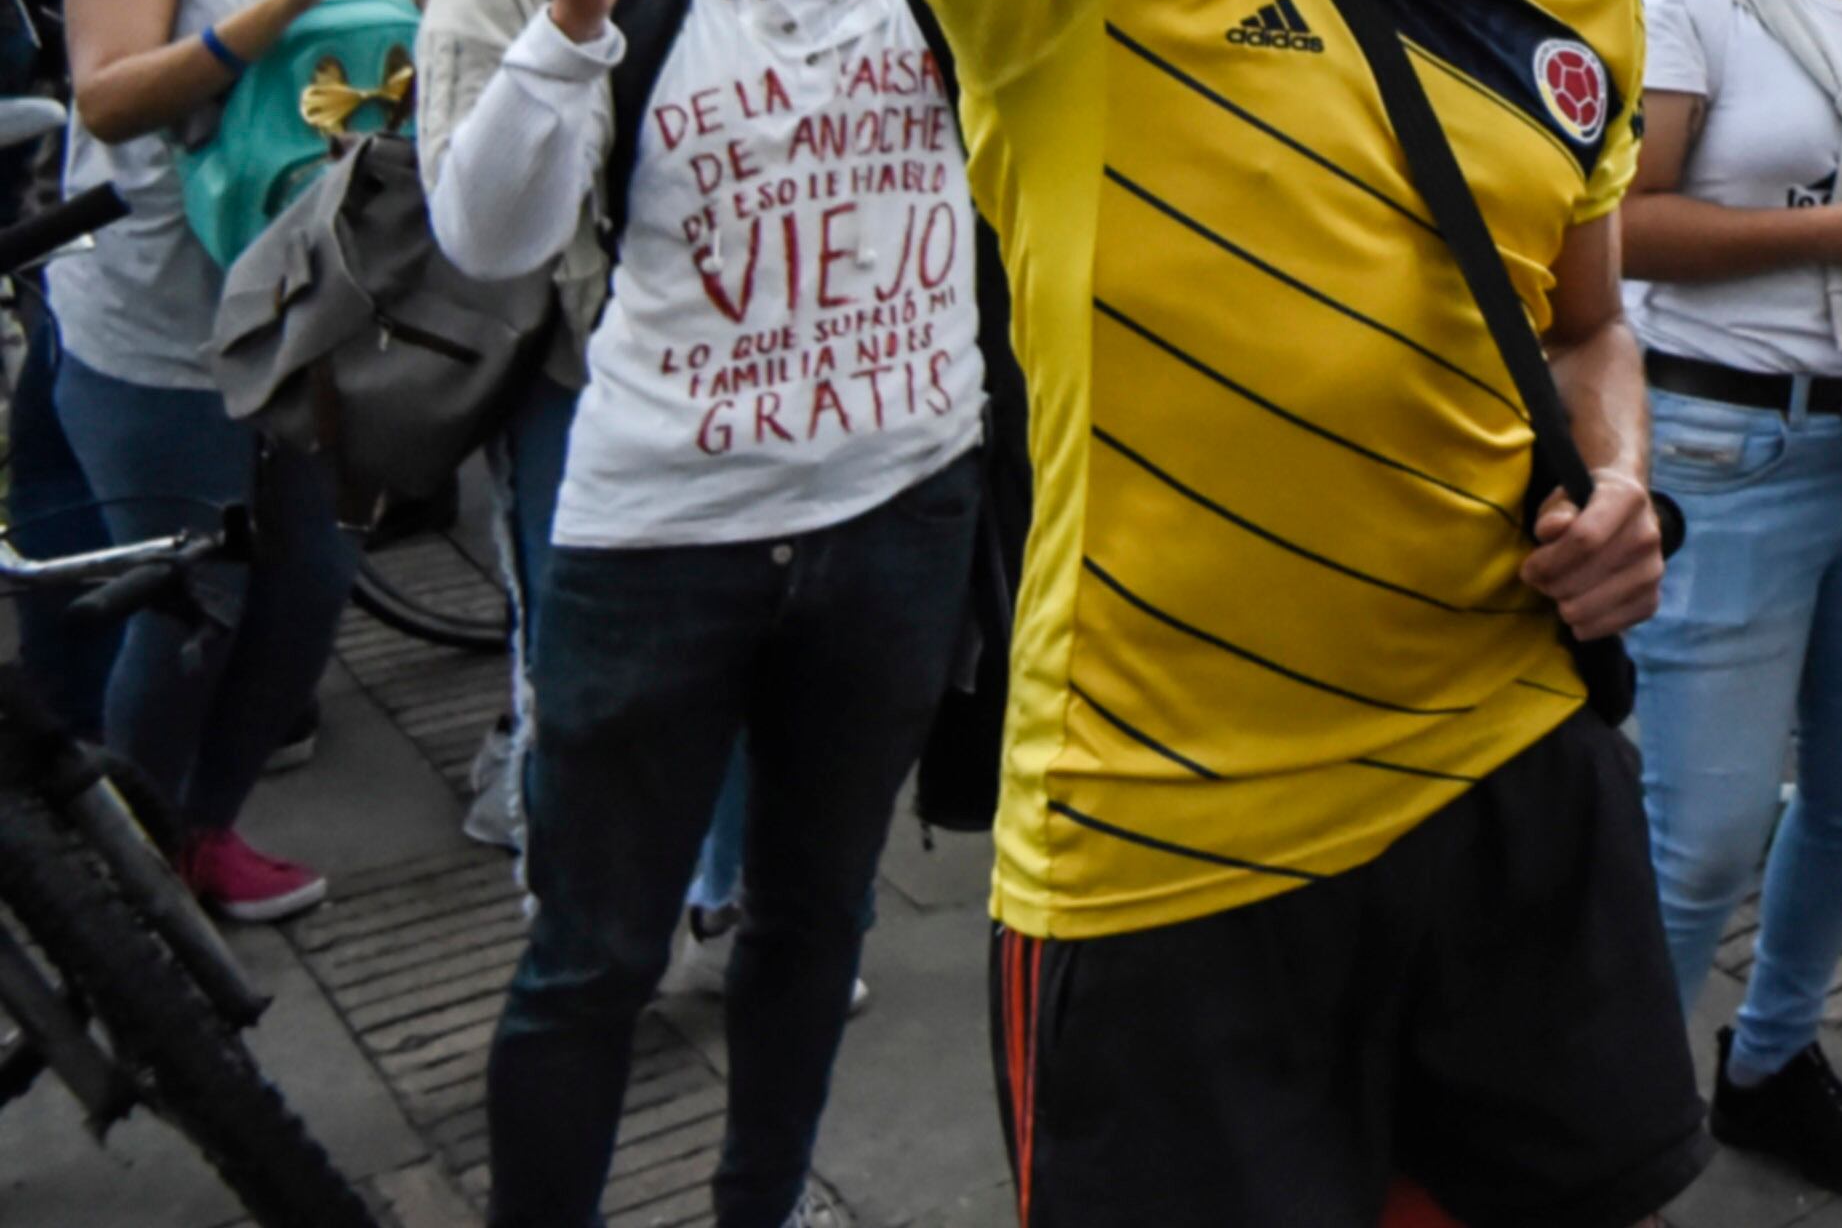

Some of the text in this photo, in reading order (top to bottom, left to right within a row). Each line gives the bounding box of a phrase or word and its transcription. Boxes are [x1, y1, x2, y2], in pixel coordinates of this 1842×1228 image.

[1225, 27, 1325, 54] adidas
[654, 87, 724, 151] DE
[734, 66, 793, 119] LA
[689, 104, 948, 195] DE ANOCHE
[733, 176, 798, 219] ESO
[692, 202, 957, 324] VIEJO
[660, 342, 712, 376] LO
[731, 324, 797, 361] QUE
[928, 284, 956, 315] MI
[694, 348, 954, 457] GRATIS
